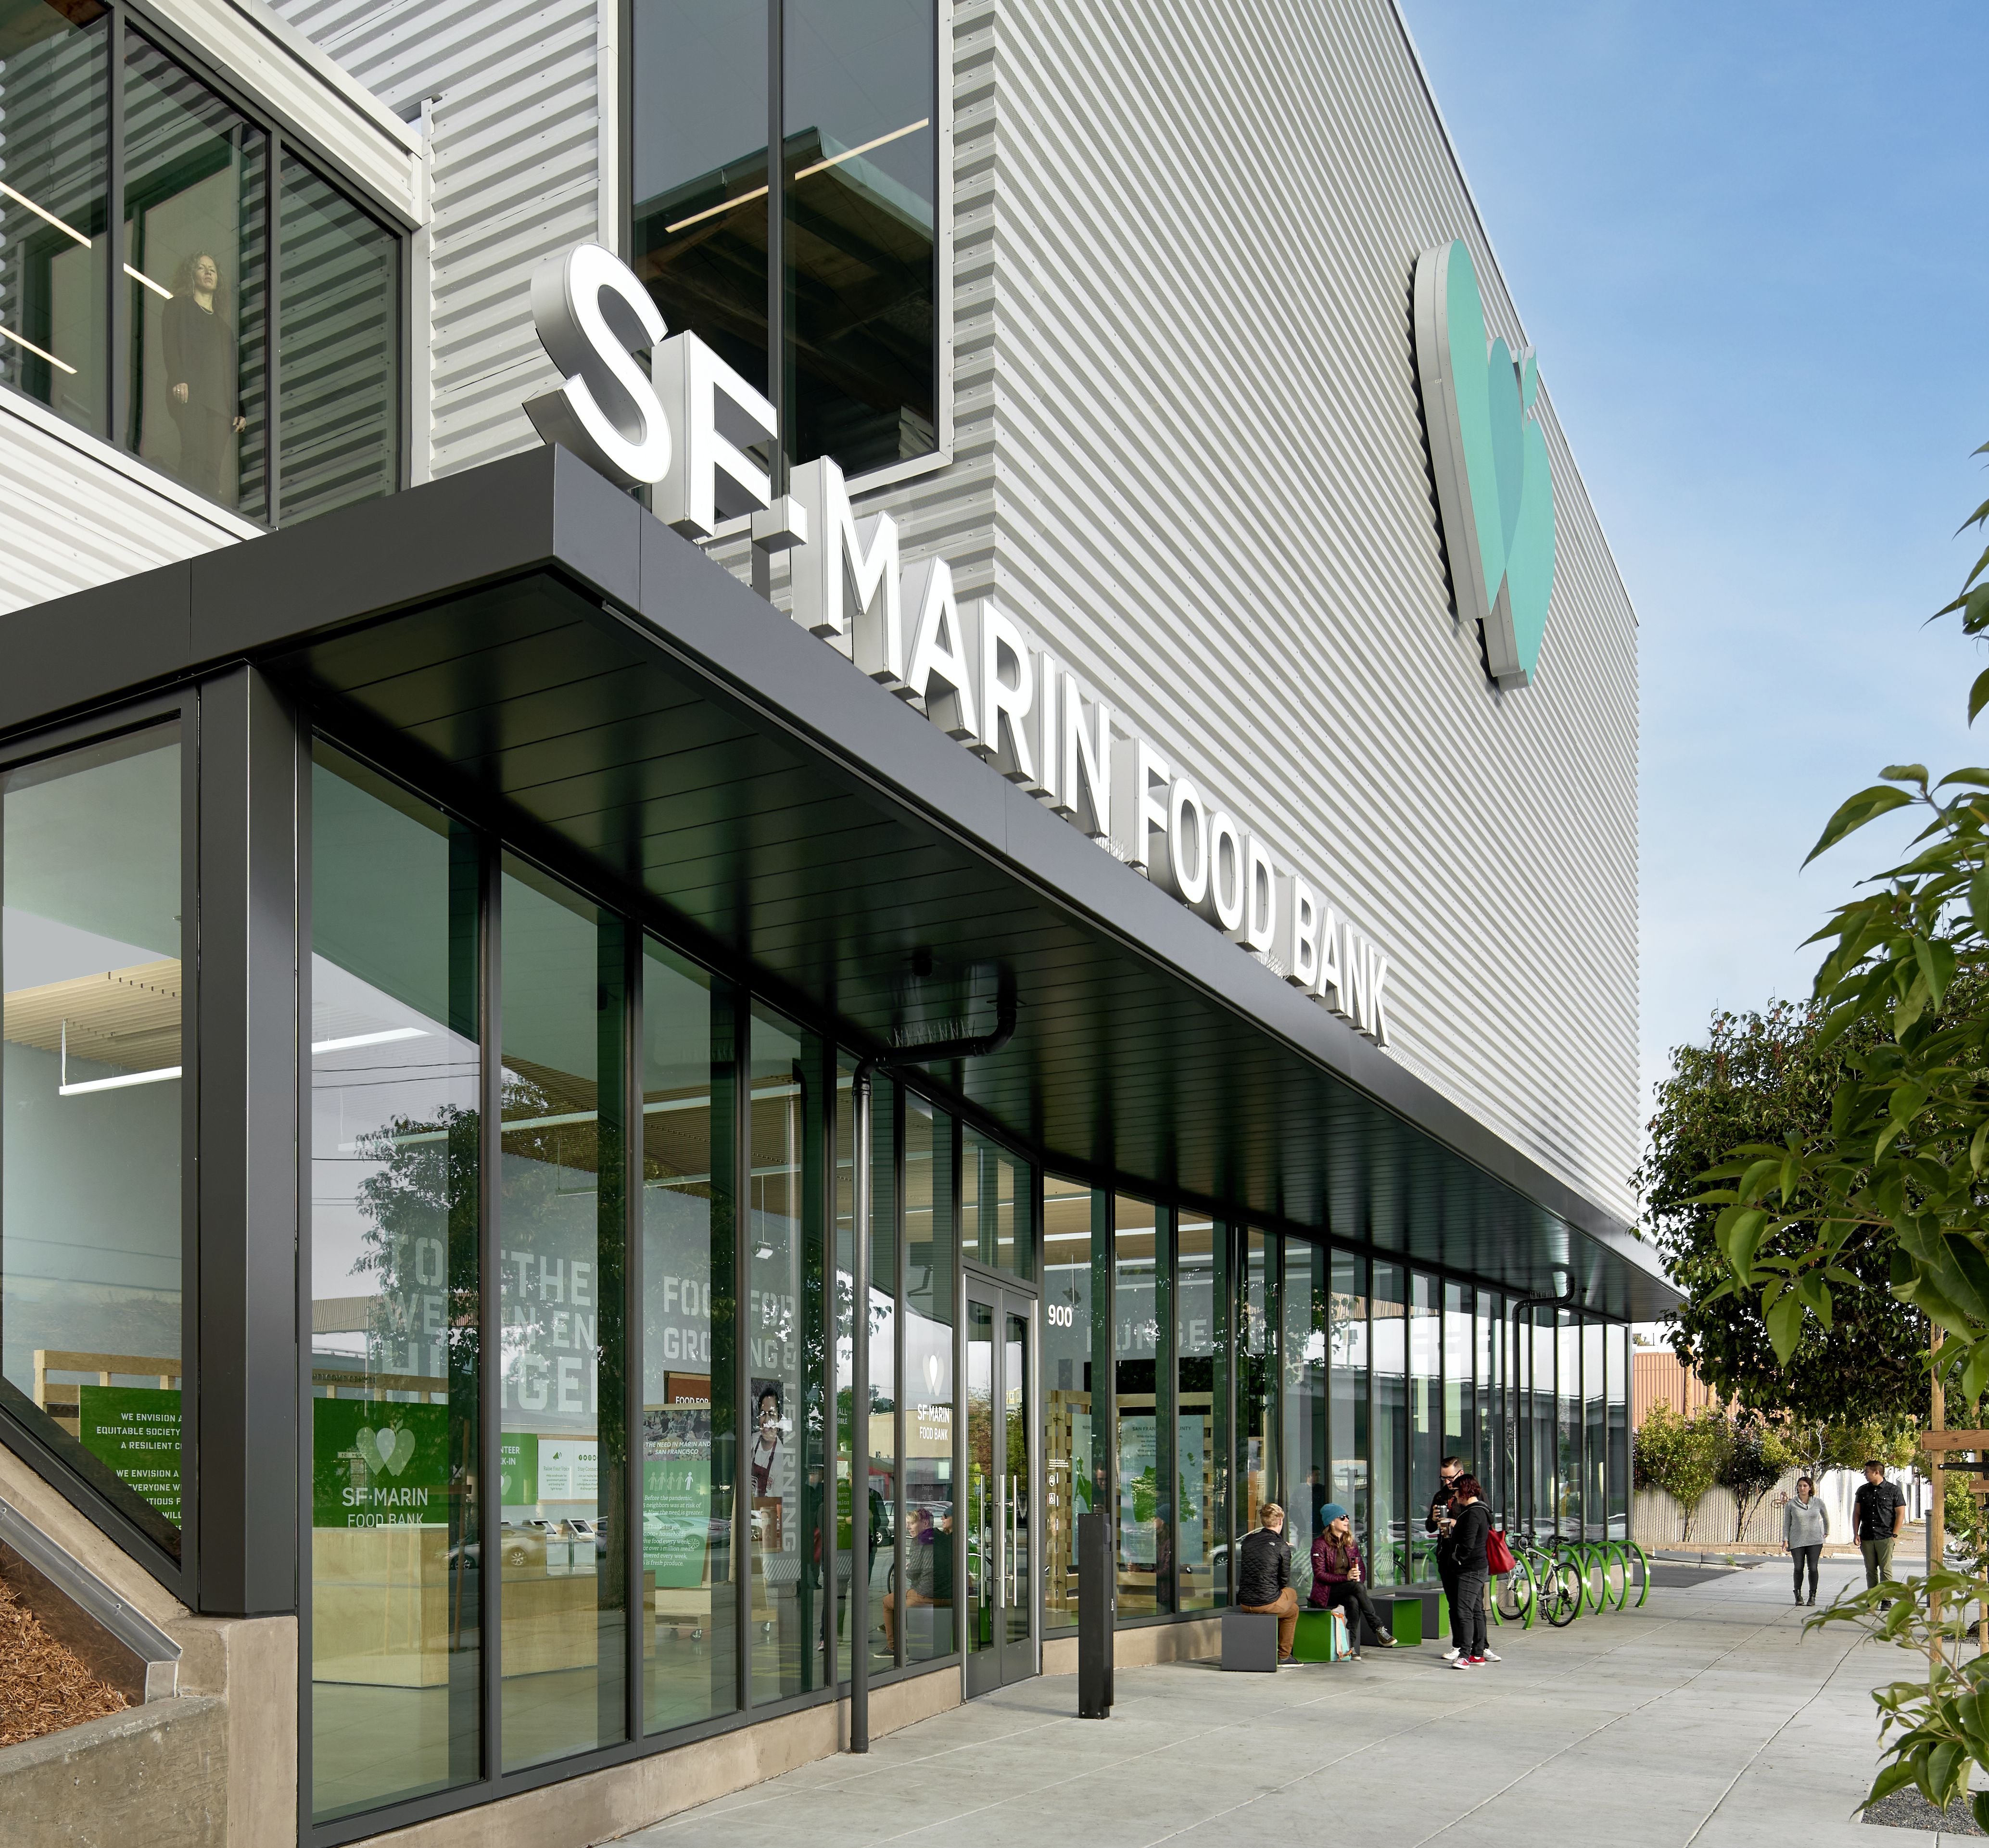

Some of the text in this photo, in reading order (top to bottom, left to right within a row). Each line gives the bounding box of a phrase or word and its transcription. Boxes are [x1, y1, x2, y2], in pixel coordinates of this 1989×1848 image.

[1136, 737, 1276, 953] FOOD
[1293, 874, 1389, 1048] BANK
[1048, 1304, 1073, 1328] 900
[675, 1396, 695, 1404] FOOD
[838, 1407, 848, 1416] ALL
[136, 1413, 176, 1422] ENVISION
[96, 1426, 181, 1436] EQUITABLE SOCIETY
[919, 1426, 948, 1441] FOOD BANK
[129, 1442, 172, 1450] RESILIENT
[501, 1446, 520, 1454] NTEER
[783, 1383, 797, 1552] LEARNING
[348, 1513, 424, 1528] FOOD BANK
